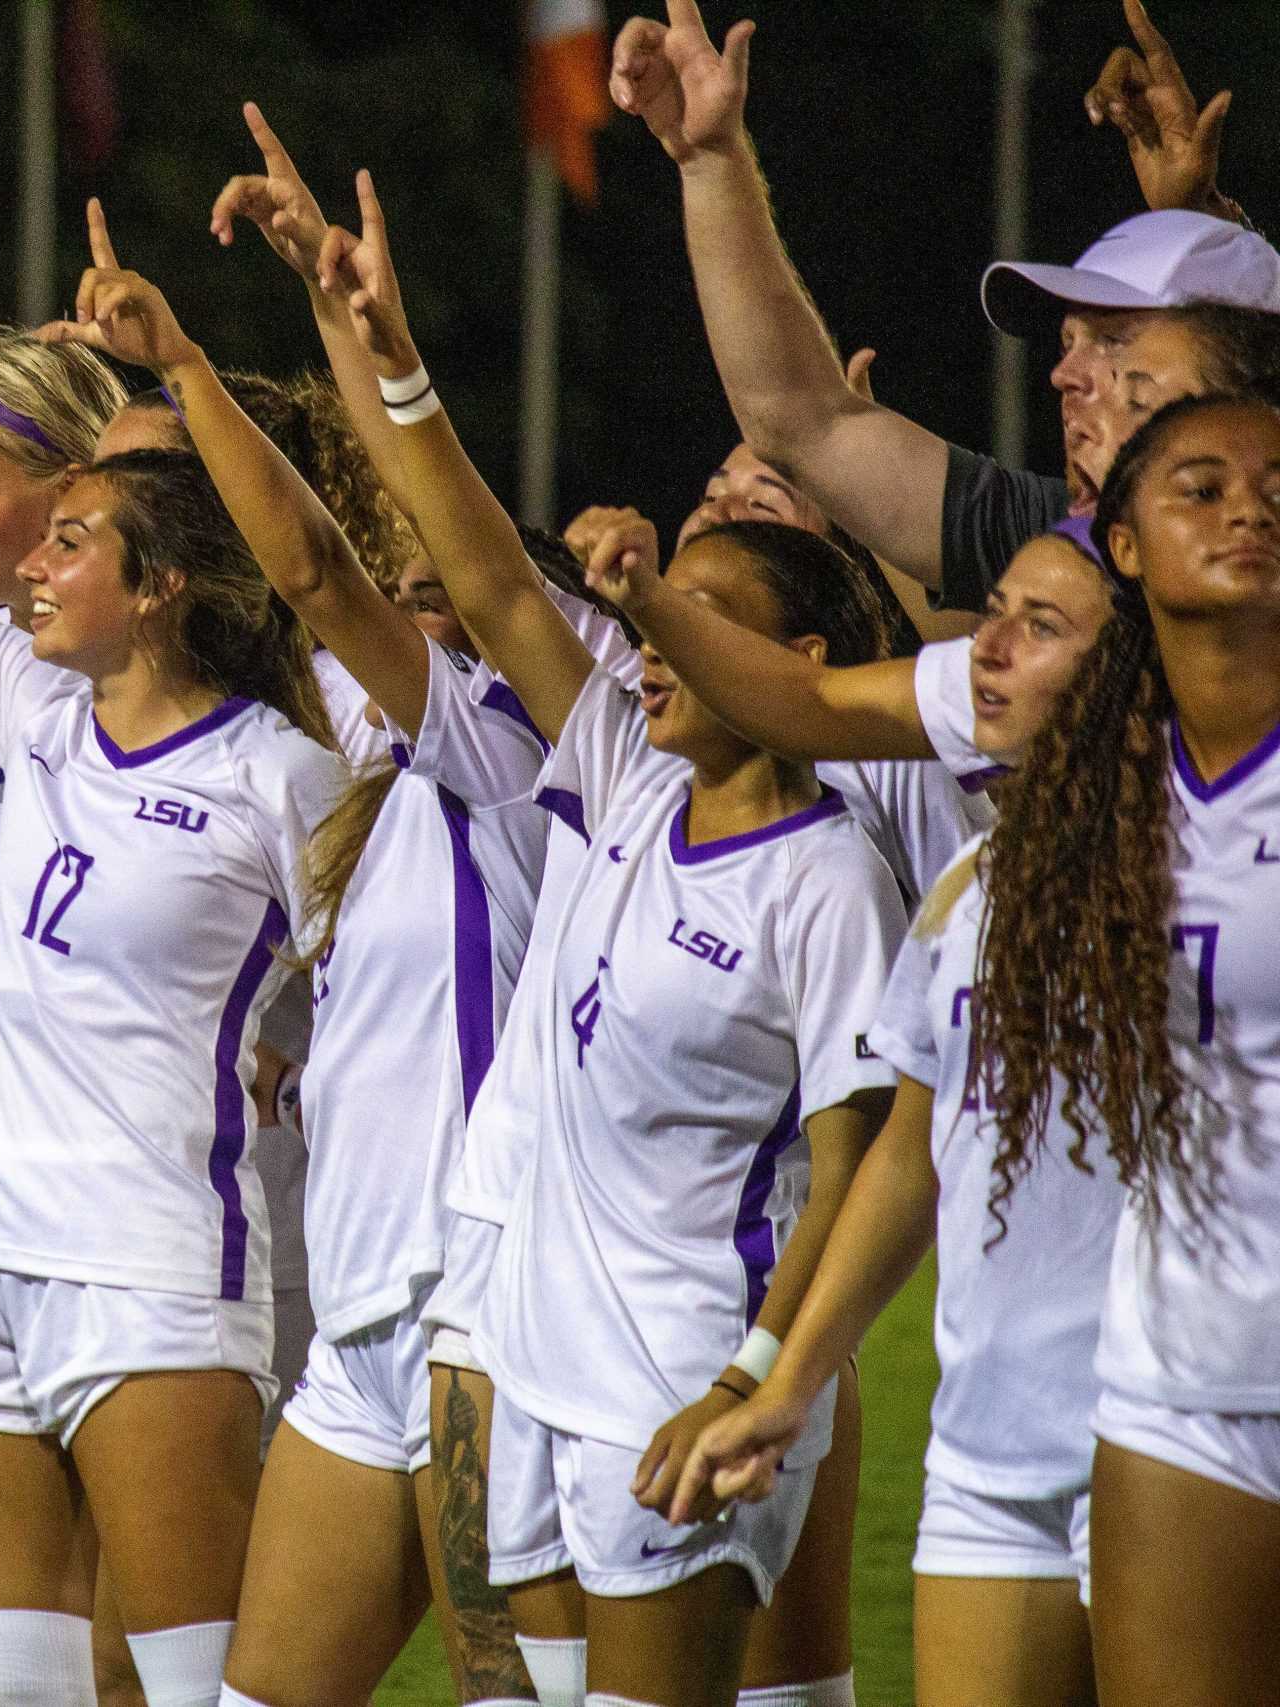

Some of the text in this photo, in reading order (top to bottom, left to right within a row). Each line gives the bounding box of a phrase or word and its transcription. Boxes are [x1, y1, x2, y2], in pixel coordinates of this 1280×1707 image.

[134, 796, 209, 833] LSU
[22, 838, 95, 956] 12
[668, 918, 744, 973] LSU
[571, 955, 609, 1070] 4
